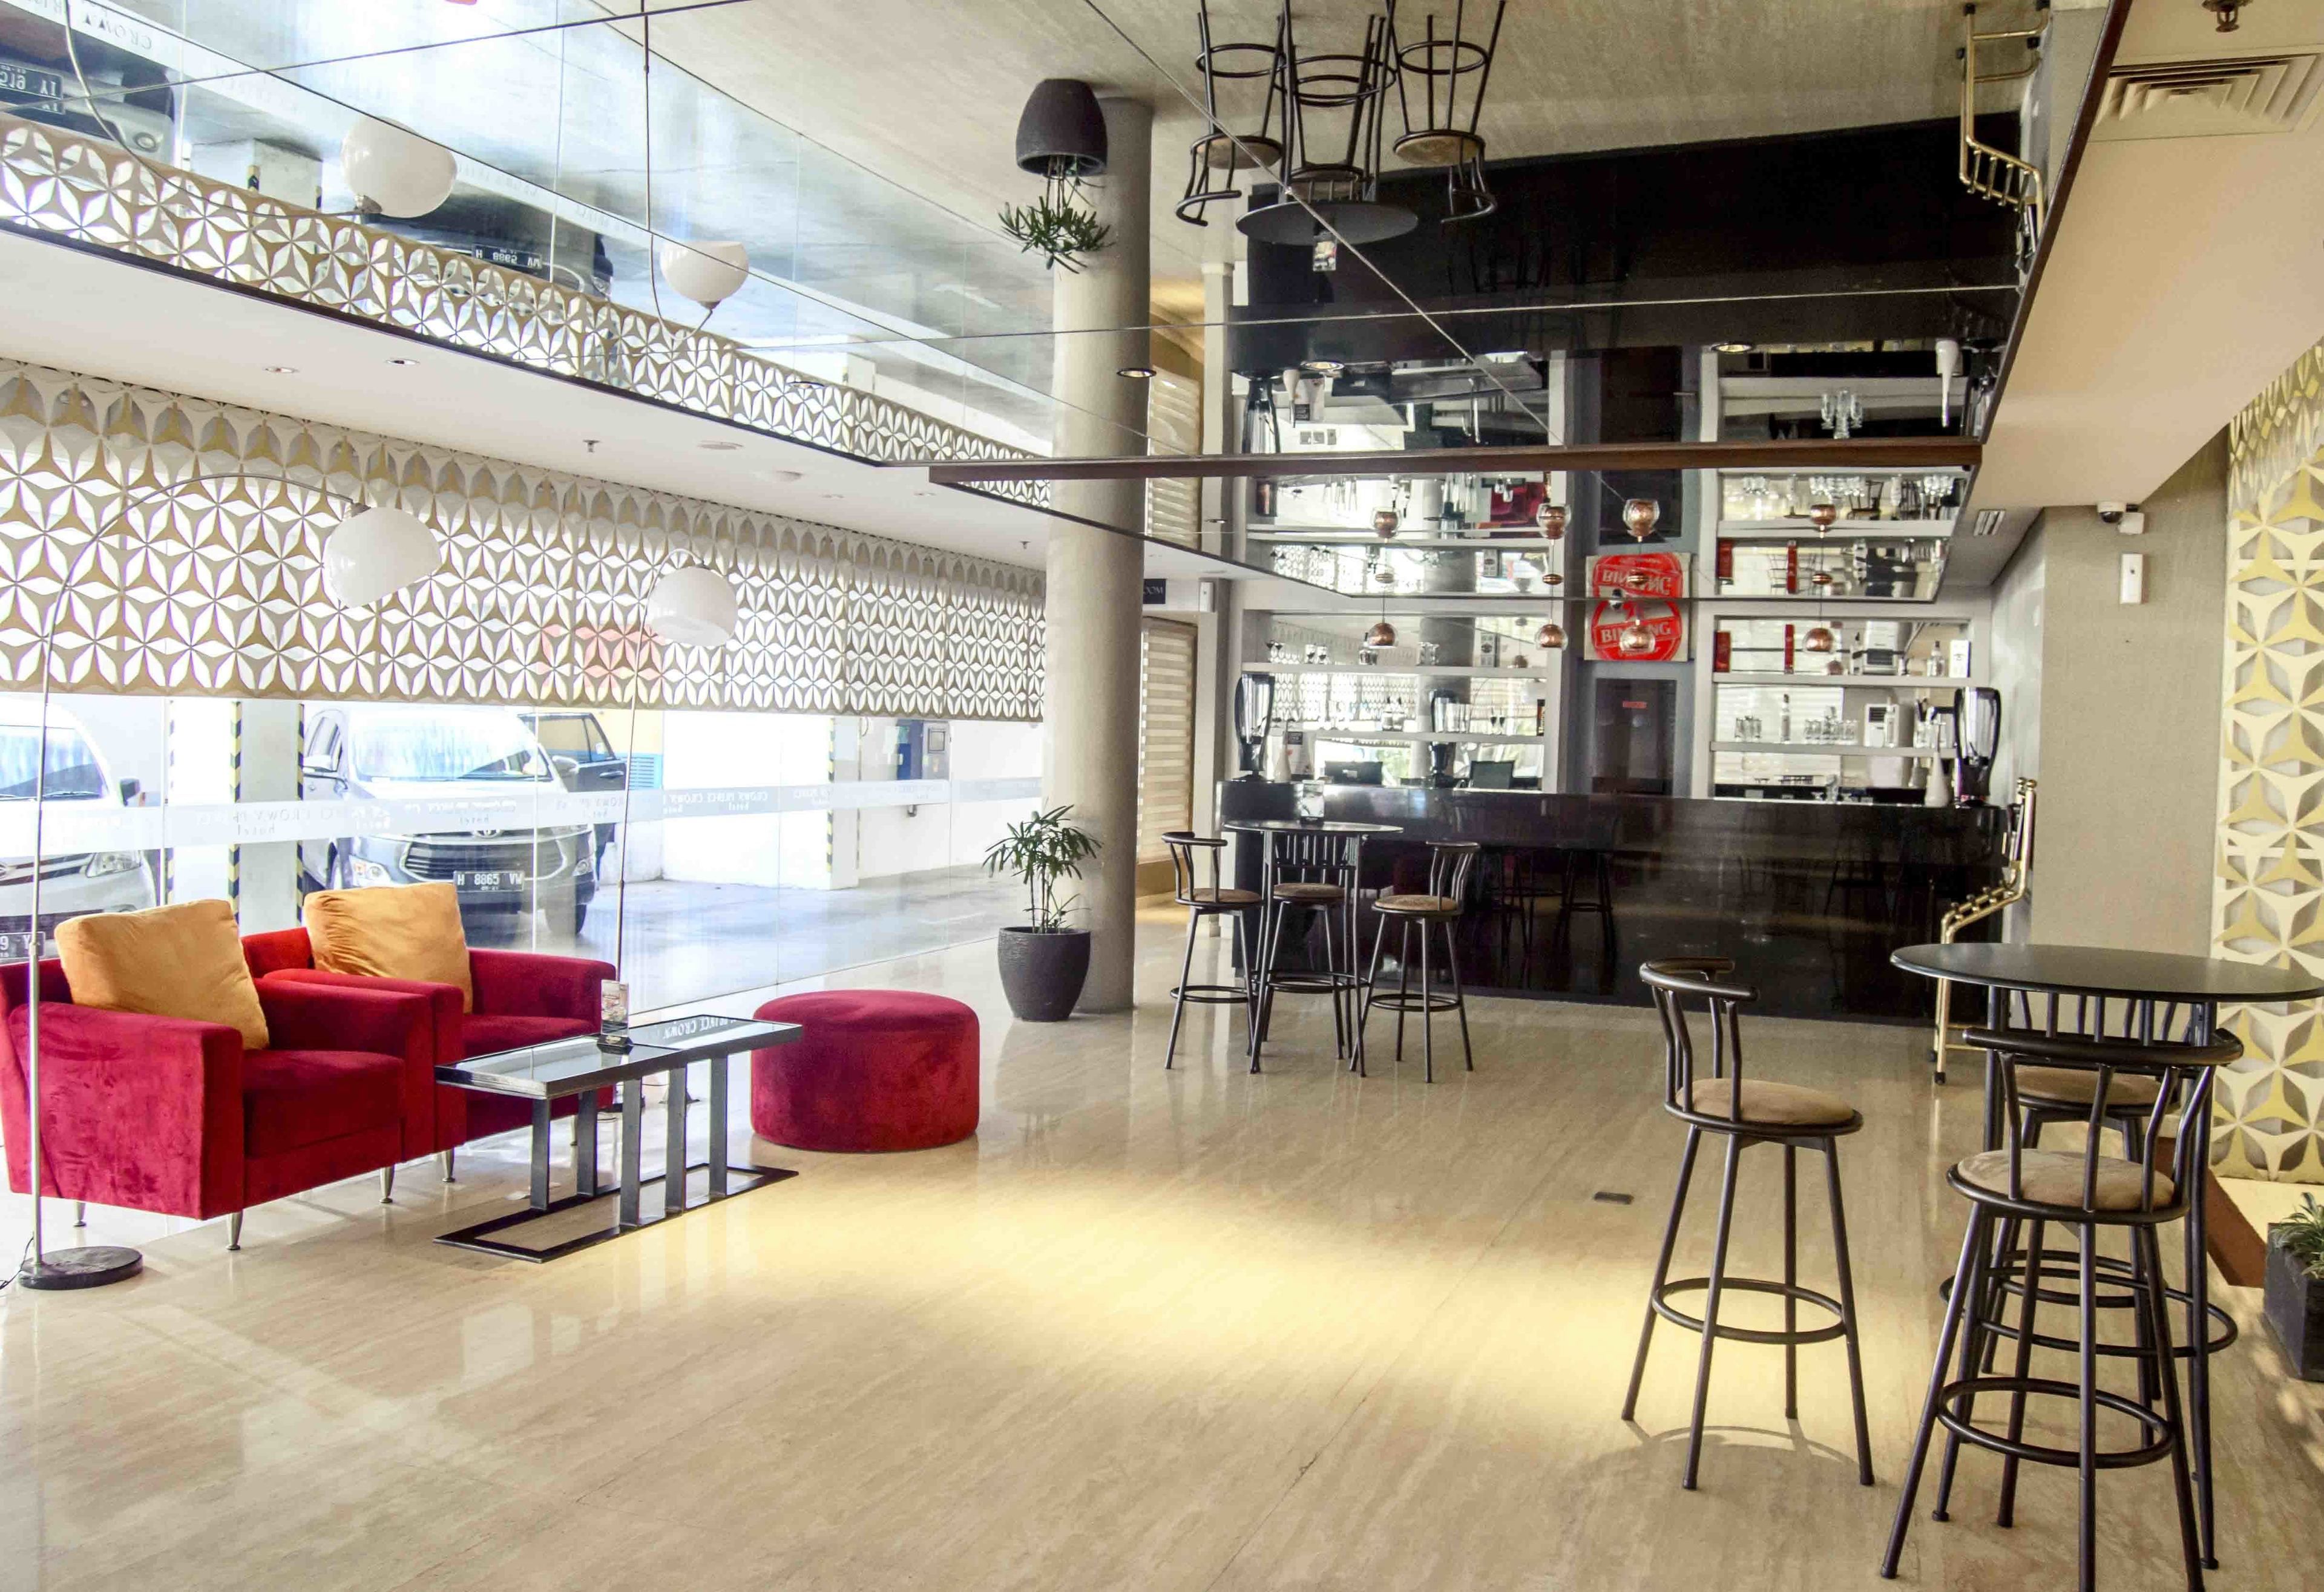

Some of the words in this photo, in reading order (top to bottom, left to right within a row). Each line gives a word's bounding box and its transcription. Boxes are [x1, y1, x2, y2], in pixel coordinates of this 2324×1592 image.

[457, 874, 465, 886] H
[474, 873, 501, 885] 8865
[509, 873, 523, 885] VW
